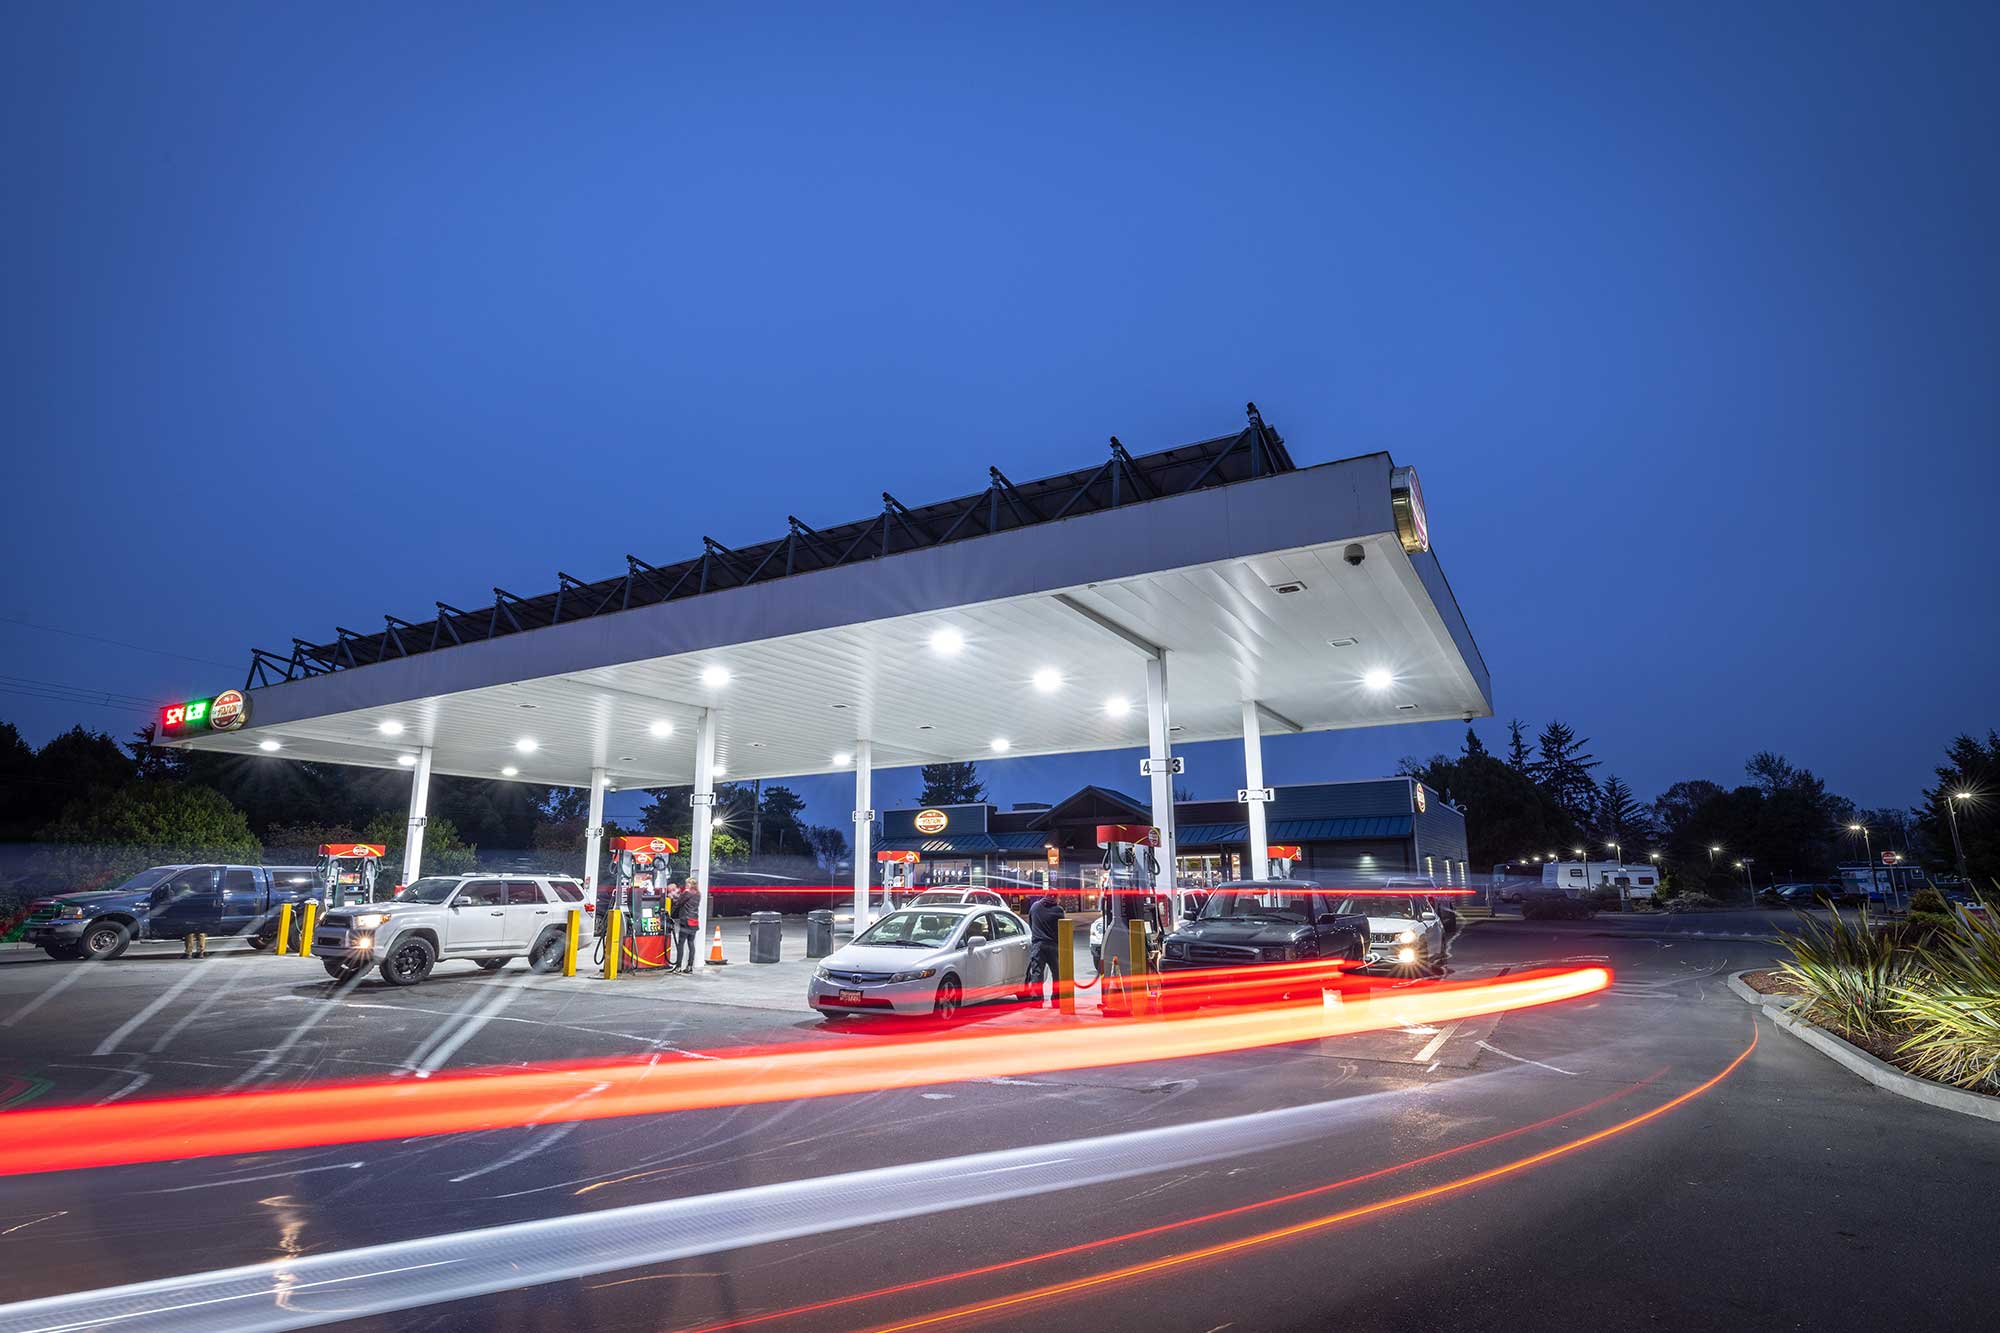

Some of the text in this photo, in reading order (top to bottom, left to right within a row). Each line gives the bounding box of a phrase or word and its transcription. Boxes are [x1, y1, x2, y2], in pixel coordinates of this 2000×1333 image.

[1143, 760, 1151, 774] 4
[1172, 759, 1181, 773] 3
[709, 794, 714, 805] 7
[1240, 790, 1248, 801] 2
[1265, 789, 1271, 800] 1
